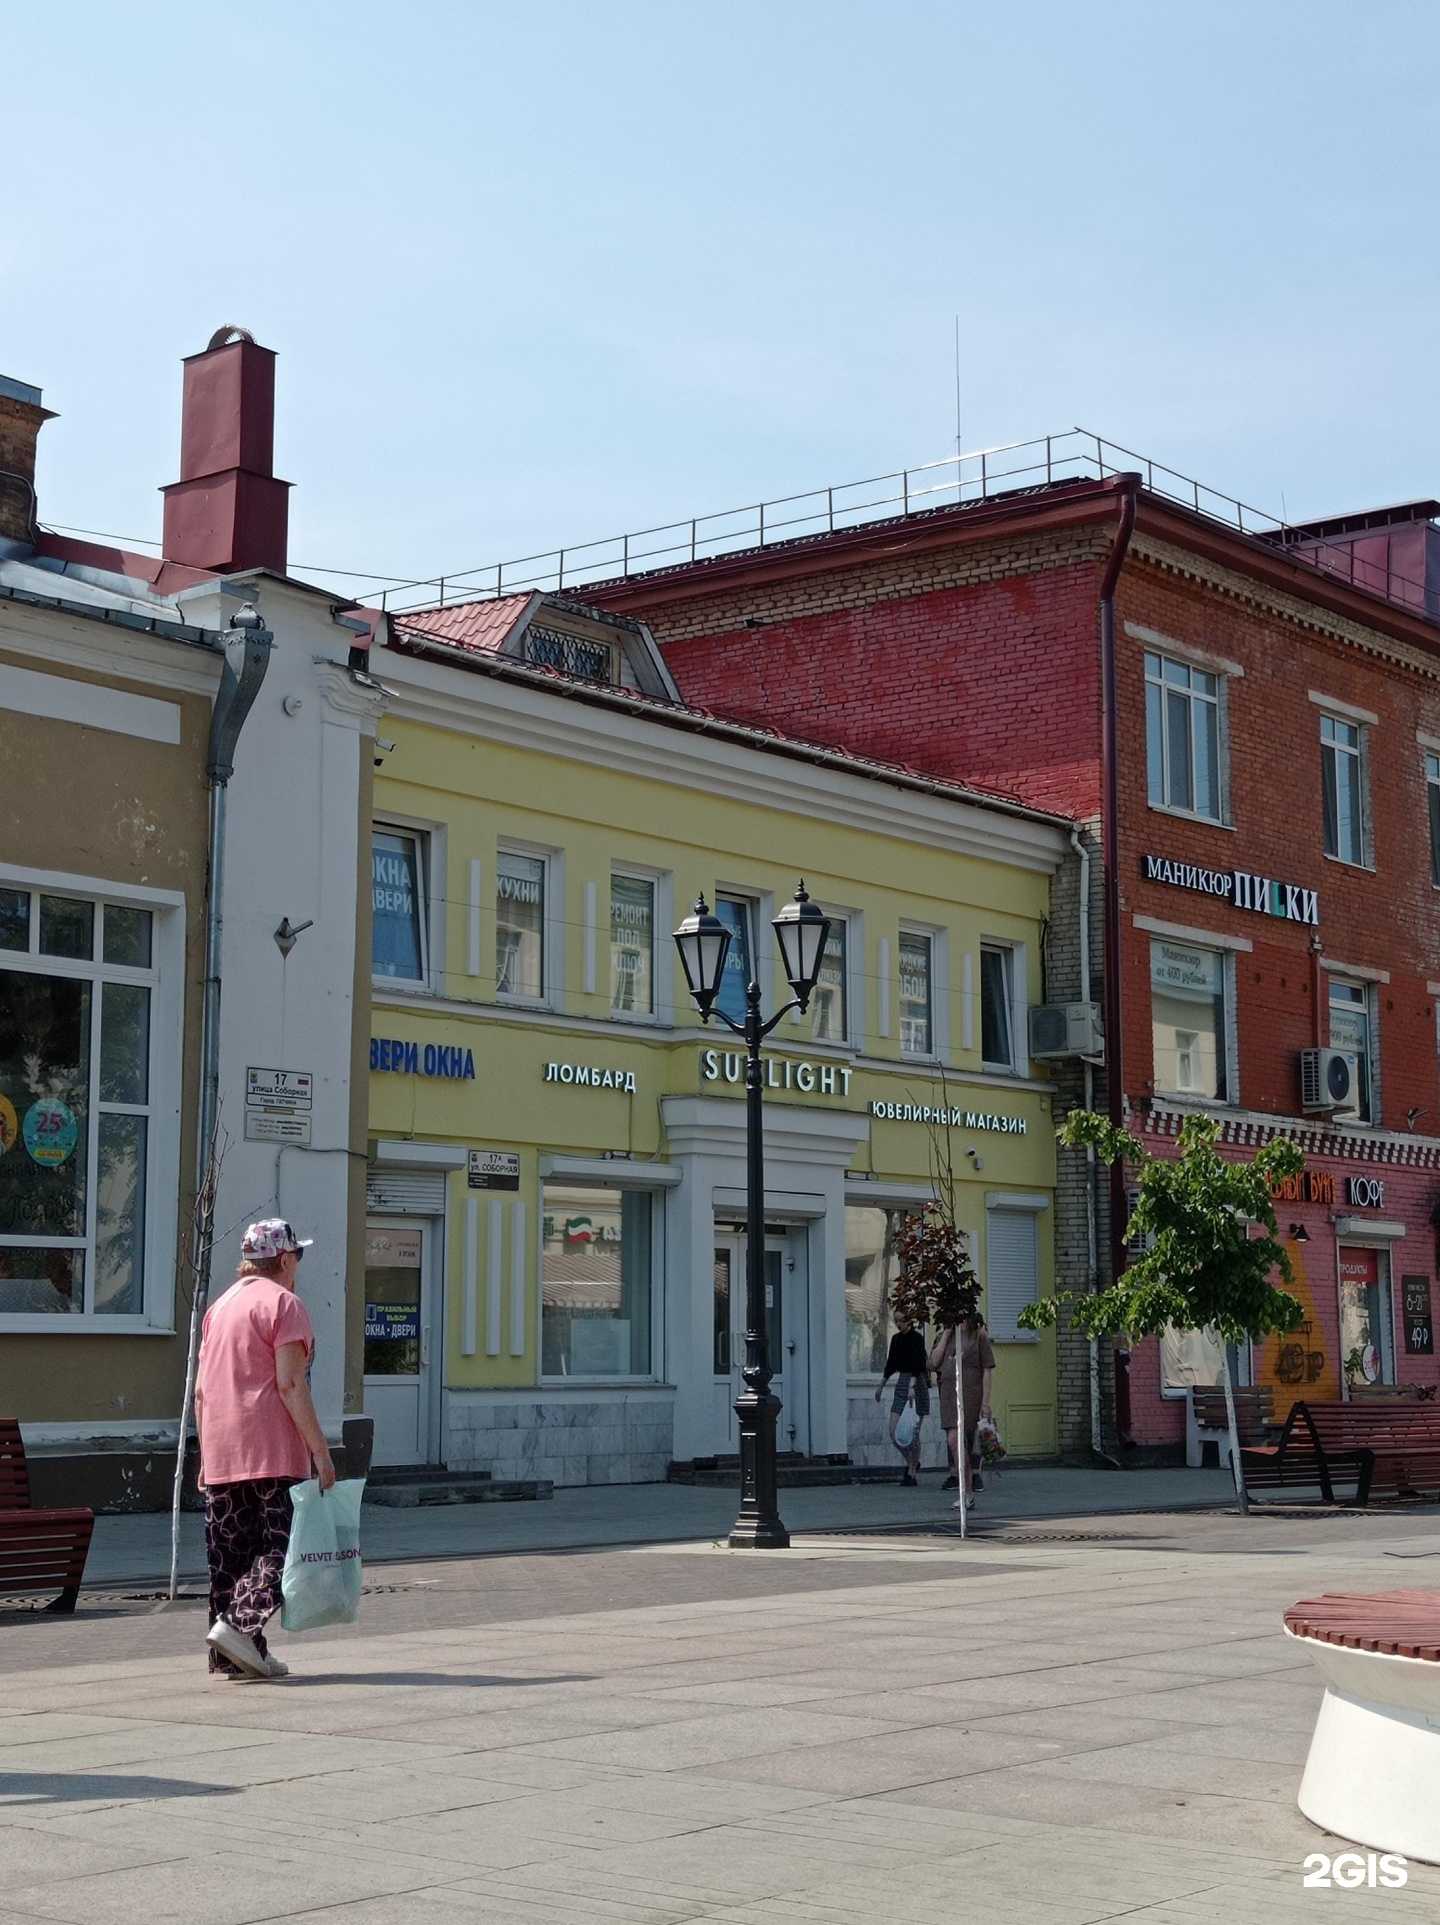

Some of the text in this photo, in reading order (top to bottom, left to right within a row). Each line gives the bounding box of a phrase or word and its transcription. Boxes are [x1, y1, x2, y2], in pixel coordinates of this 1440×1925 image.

[371, 855, 412, 888] КНА
[1147, 855, 1232, 897] МАНИКЮР
[371, 886, 412, 914] ВЕРИ
[423, 1043, 476, 1080] ОКНА
[705, 1050, 853, 1097] SULIGHT
[274, 1073, 288, 1086] 17
[546, 1063, 637, 1094] ЛОМБАРД
[872, 1101, 1027, 1135] ЮВЕЛИРНЫЙ МАГАЗИН
[1351, 1176, 1385, 1209] КОФЕ
[365, 1323, 417, 1339] ОКНА ДВЕРИ
